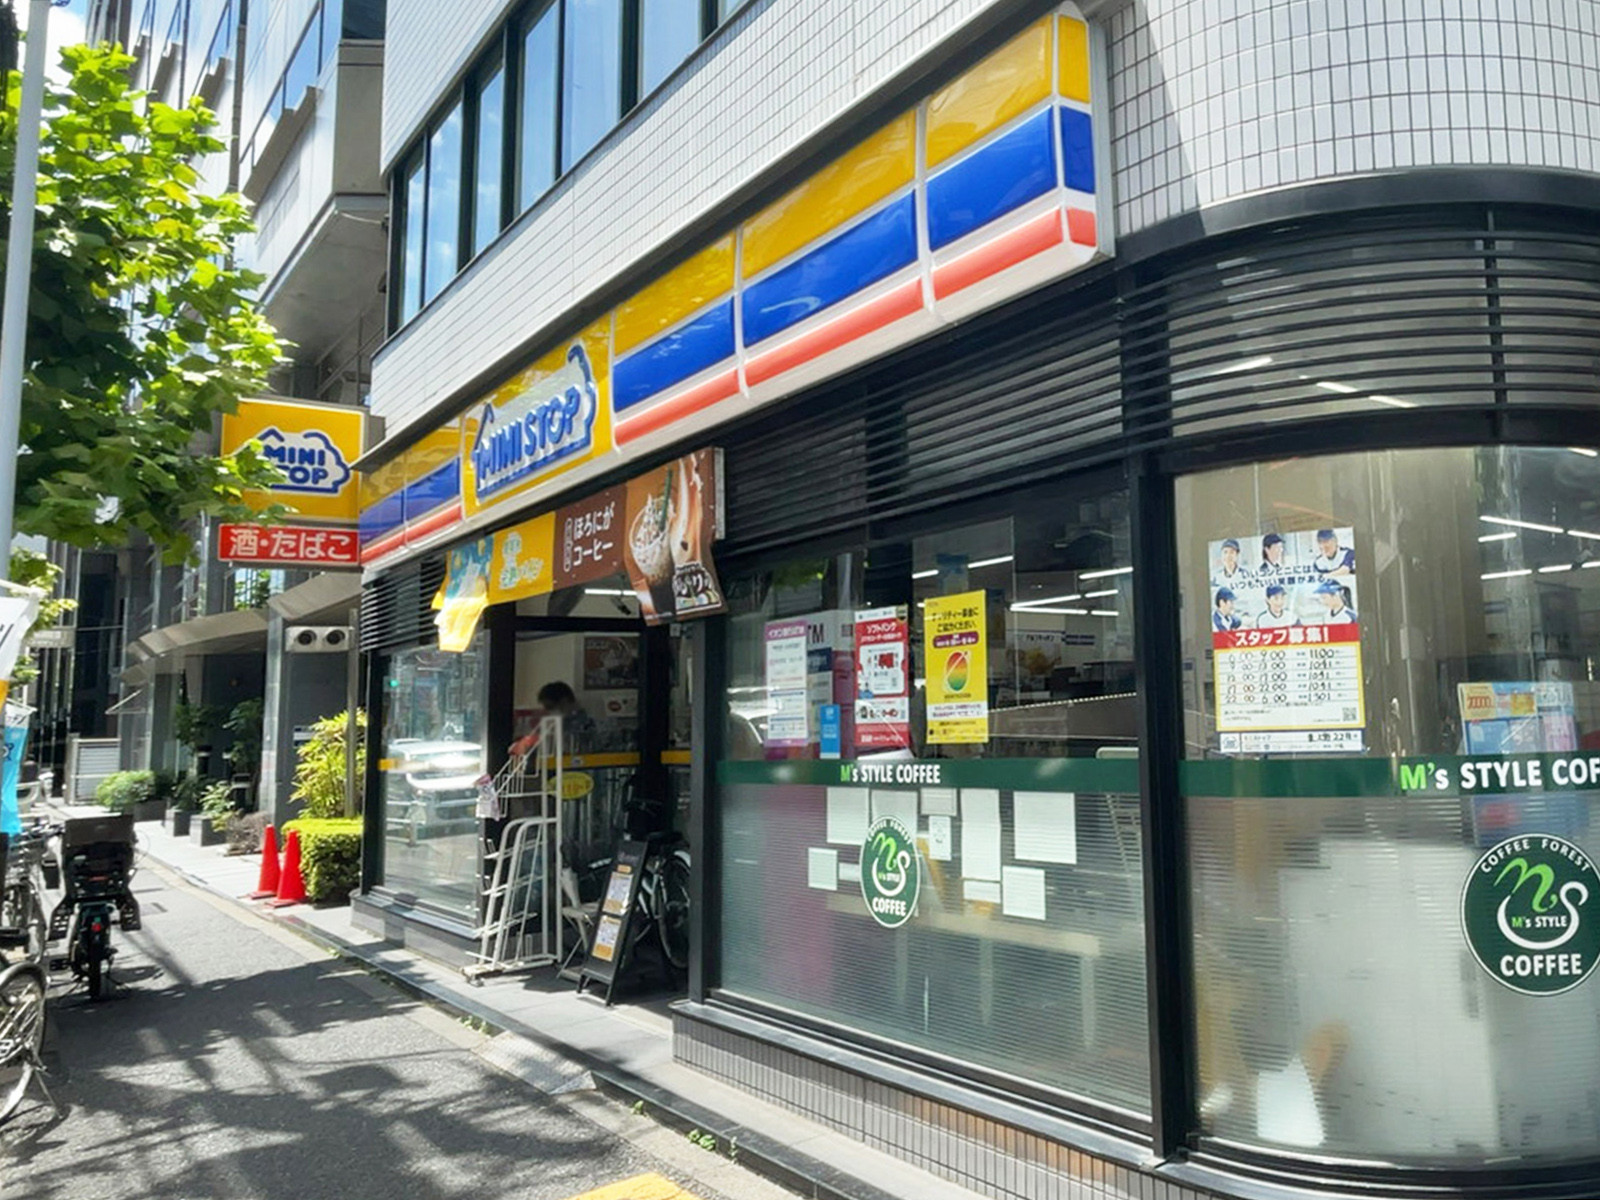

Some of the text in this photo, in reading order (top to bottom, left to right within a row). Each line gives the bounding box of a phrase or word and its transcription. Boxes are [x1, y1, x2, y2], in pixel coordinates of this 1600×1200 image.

[479, 385, 581, 480] MINI STOP
[263, 445, 325, 466] MINI
[574, 501, 615, 540] ほろにが
[229, 529, 351, 559] 酒・たばこ
[573, 538, 614, 567] コーヒー
[861, 764, 893, 784] STYLE
[896, 764, 941, 784] COFFEE
[1460, 760, 1542, 789] STYLE
[1480, 838, 1590, 873] COFFEE FOREST
[872, 896, 907, 917] COFFEE
[1535, 916, 1568, 928] STYLE
[1500, 953, 1583, 977] COFFEE
